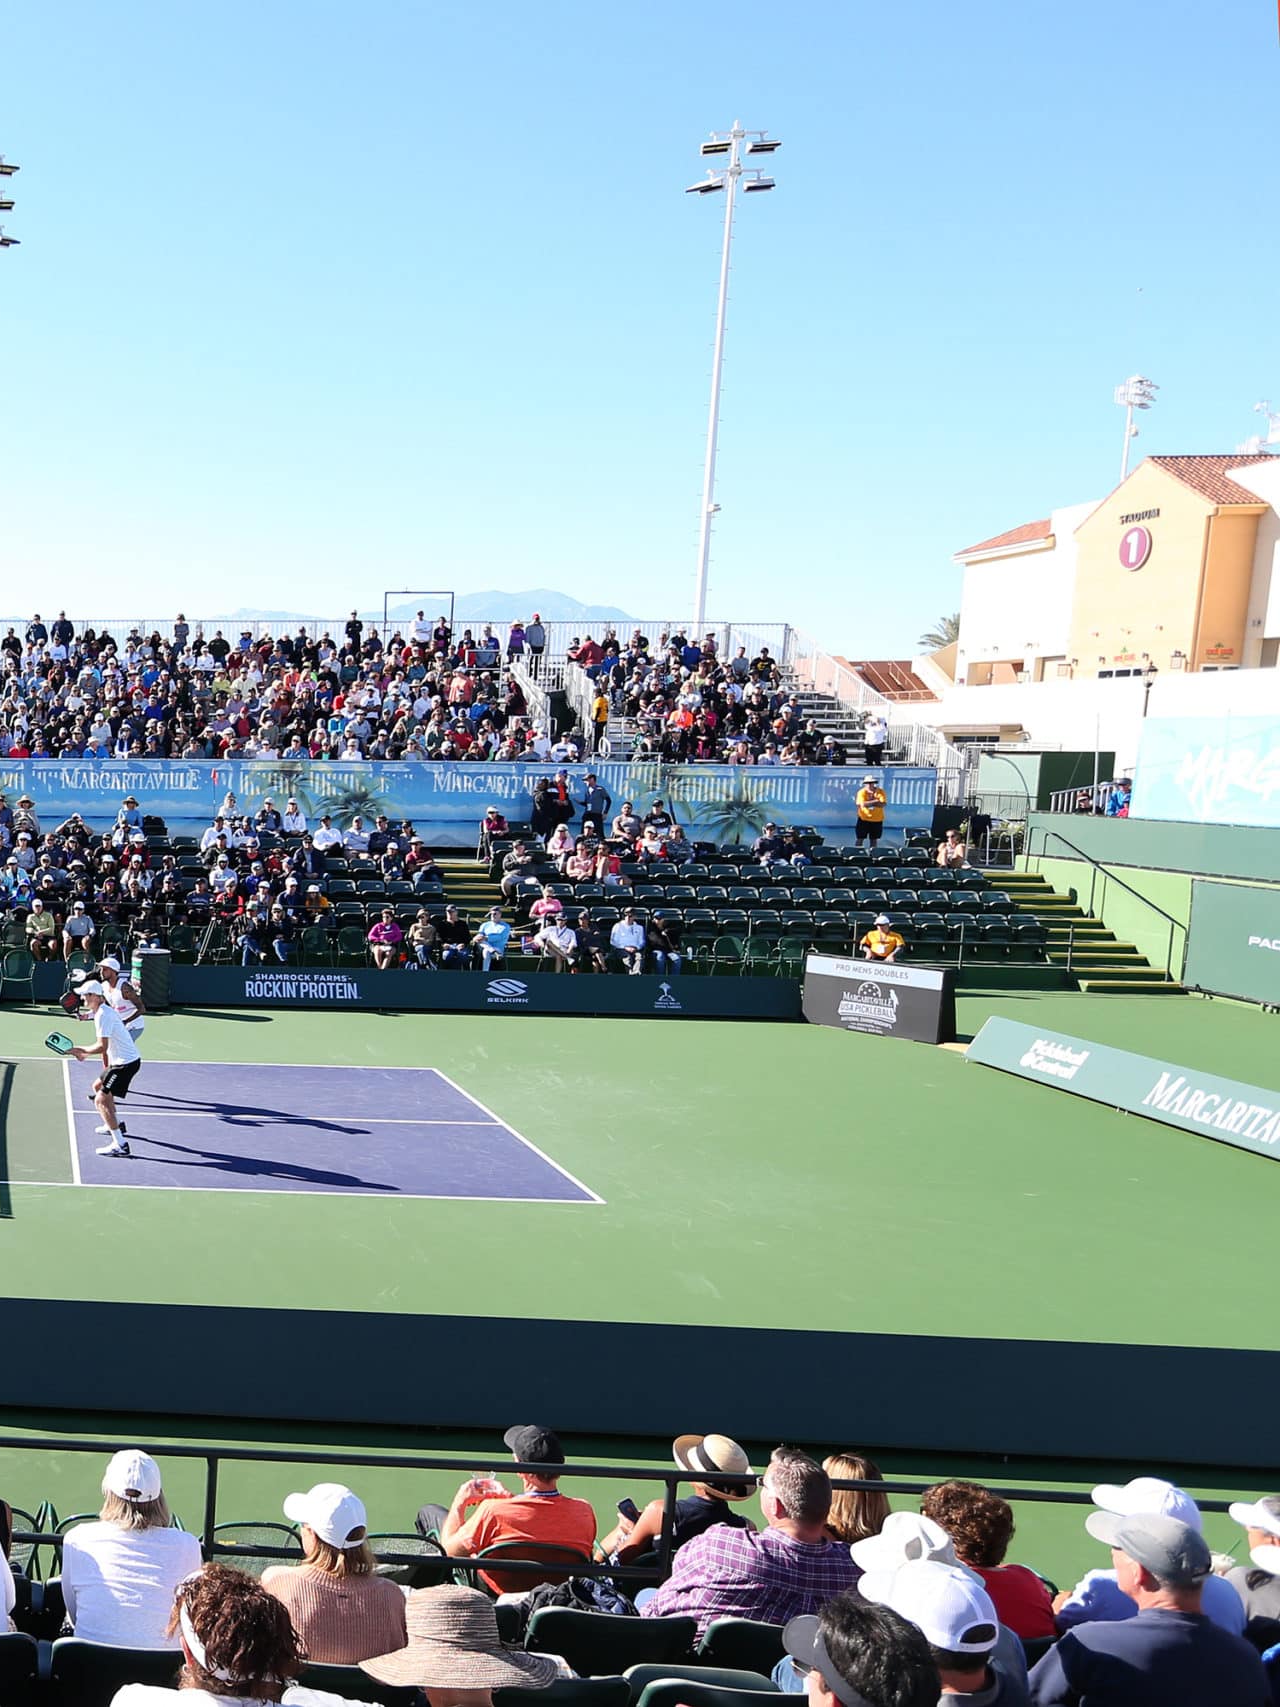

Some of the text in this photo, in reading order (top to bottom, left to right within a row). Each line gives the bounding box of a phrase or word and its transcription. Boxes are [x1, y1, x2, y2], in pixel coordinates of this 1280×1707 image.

[1126, 531, 1139, 563] 1
[61, 768, 201, 790] MARGARITAVILLE
[255, 973, 347, 982] SHAMROCK FARMS
[835, 963, 909, 979] PRO MENS DOUBLES
[245, 981, 358, 1000] ROCKIN' PROTEIN
[854, 1003, 894, 1018] PICKLEBALL
